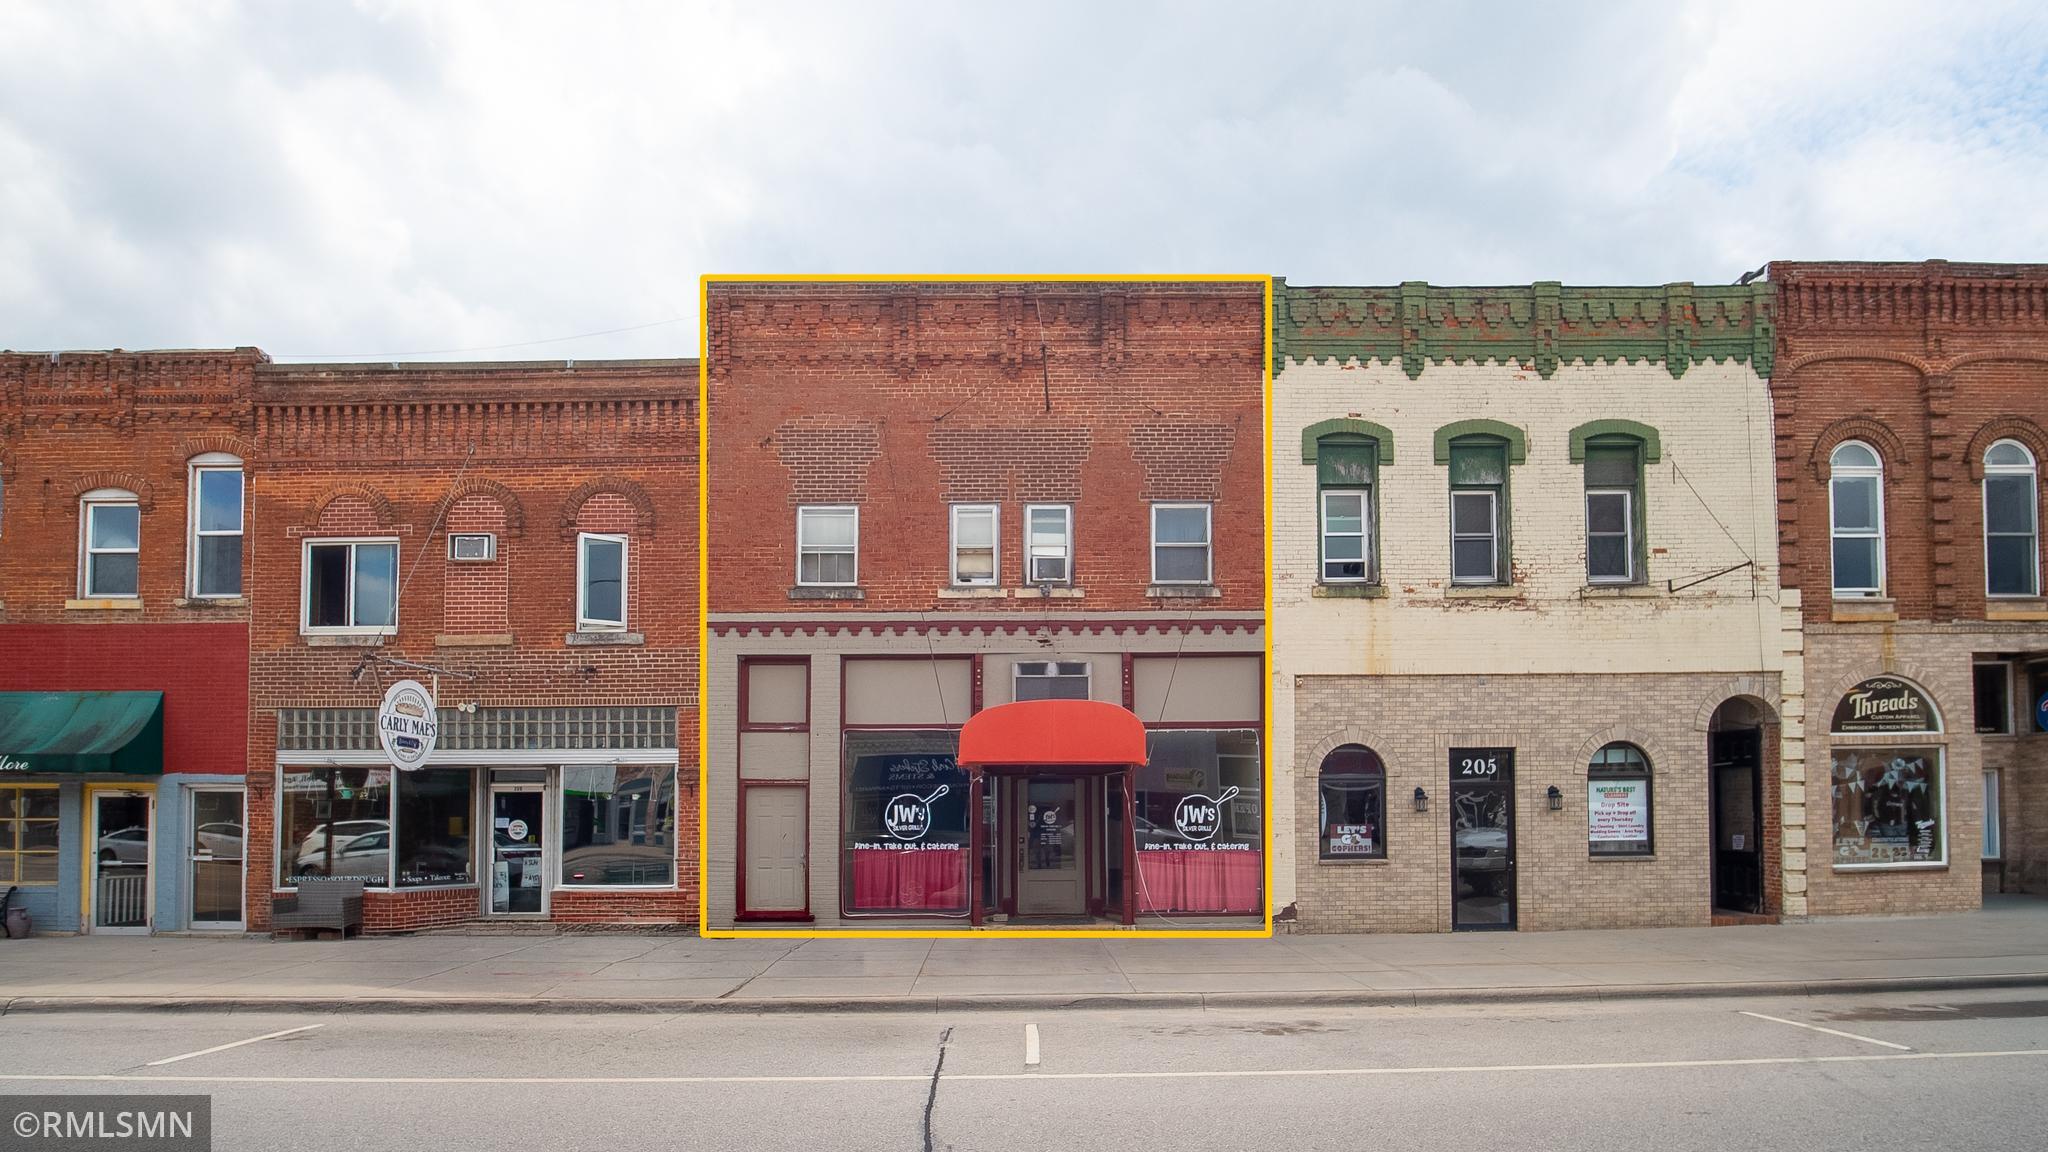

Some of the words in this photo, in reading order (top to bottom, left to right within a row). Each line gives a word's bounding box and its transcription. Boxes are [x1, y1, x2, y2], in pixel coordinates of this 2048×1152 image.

[1849, 689, 1919, 719] Threads
[380, 714, 409, 733] CARLY
[411, 720, 436, 737] MAE'S
[1462, 758, 1497, 775] 205
[1177, 804, 1216, 827] JW's
[1336, 825, 1367, 834] LET'S
[884, 842, 902, 850] Take
[926, 842, 960, 851] Catering
[1216, 843, 1250, 851] Catering
